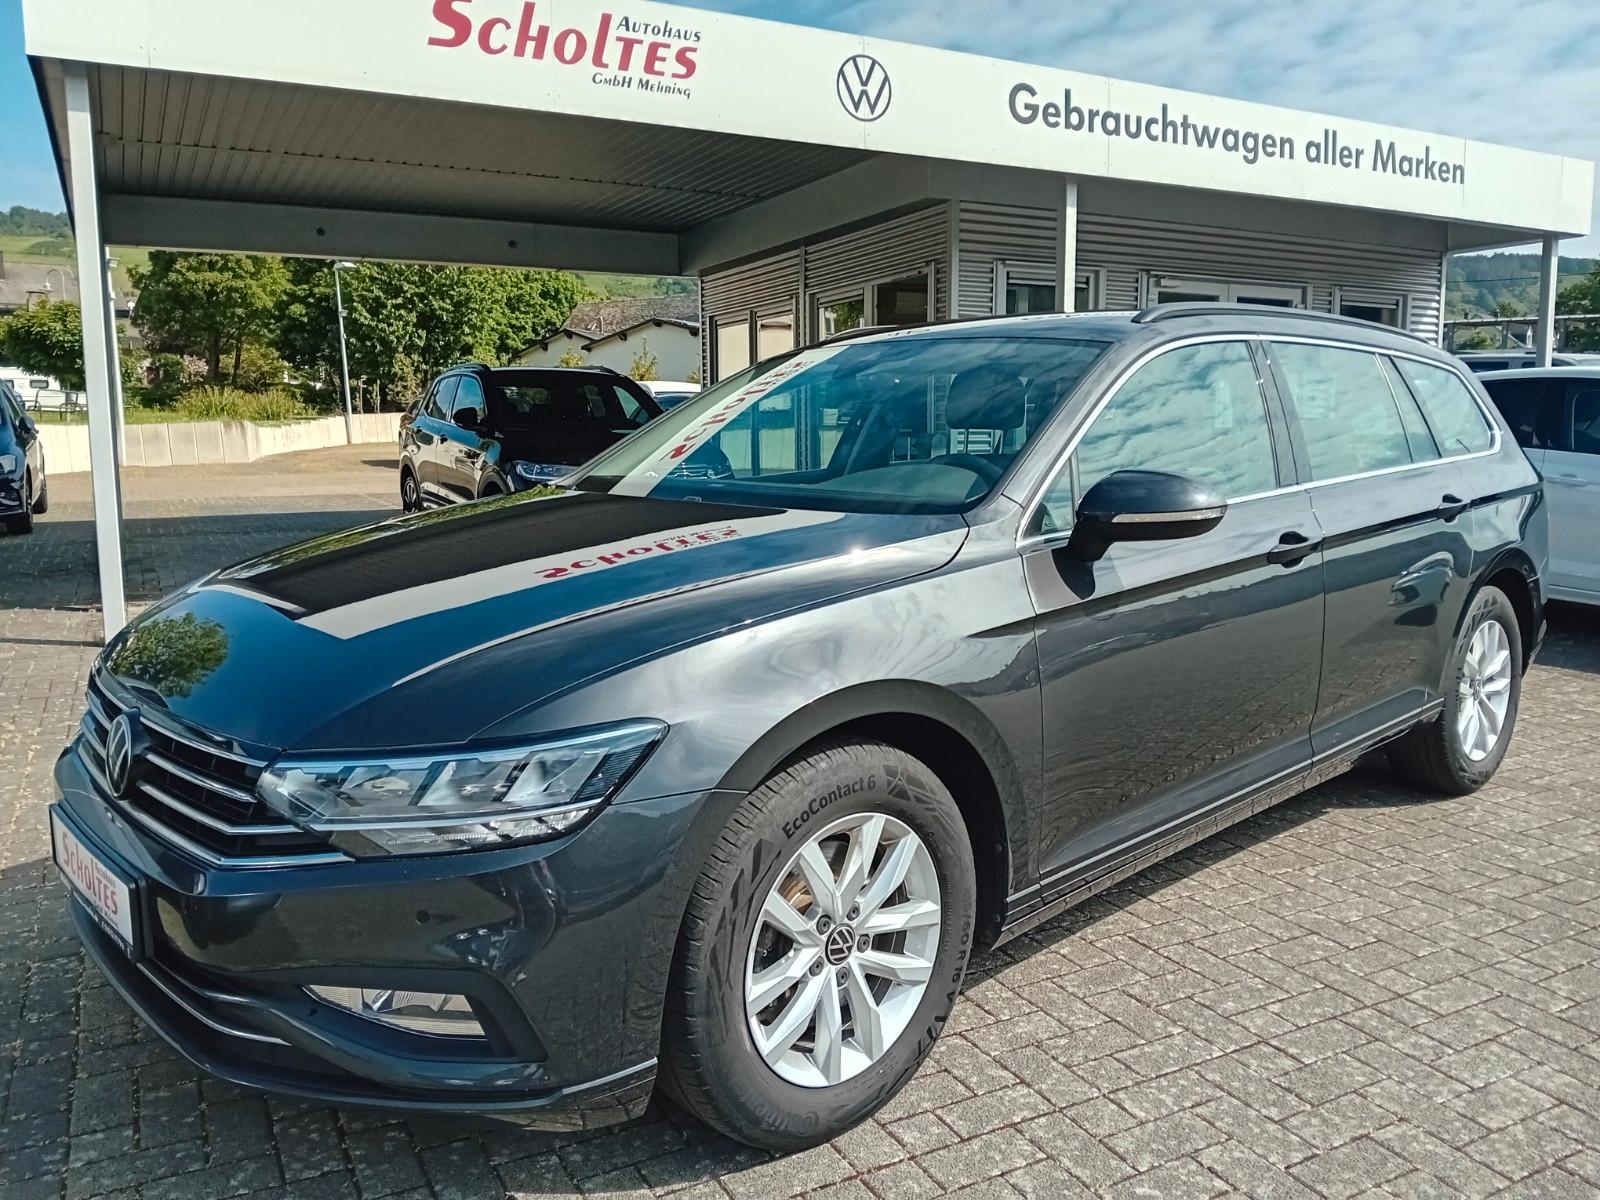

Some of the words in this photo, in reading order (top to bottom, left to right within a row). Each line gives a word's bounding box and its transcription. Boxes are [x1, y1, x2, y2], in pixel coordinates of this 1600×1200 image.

[1008, 82, 1295, 165] Gebrauchtwagen
[1305, 128, 1365, 169] aller
[1372, 138, 1466, 185] Marken
[781, 776, 865, 840] EcoContact
[867, 774, 877, 791] 6
